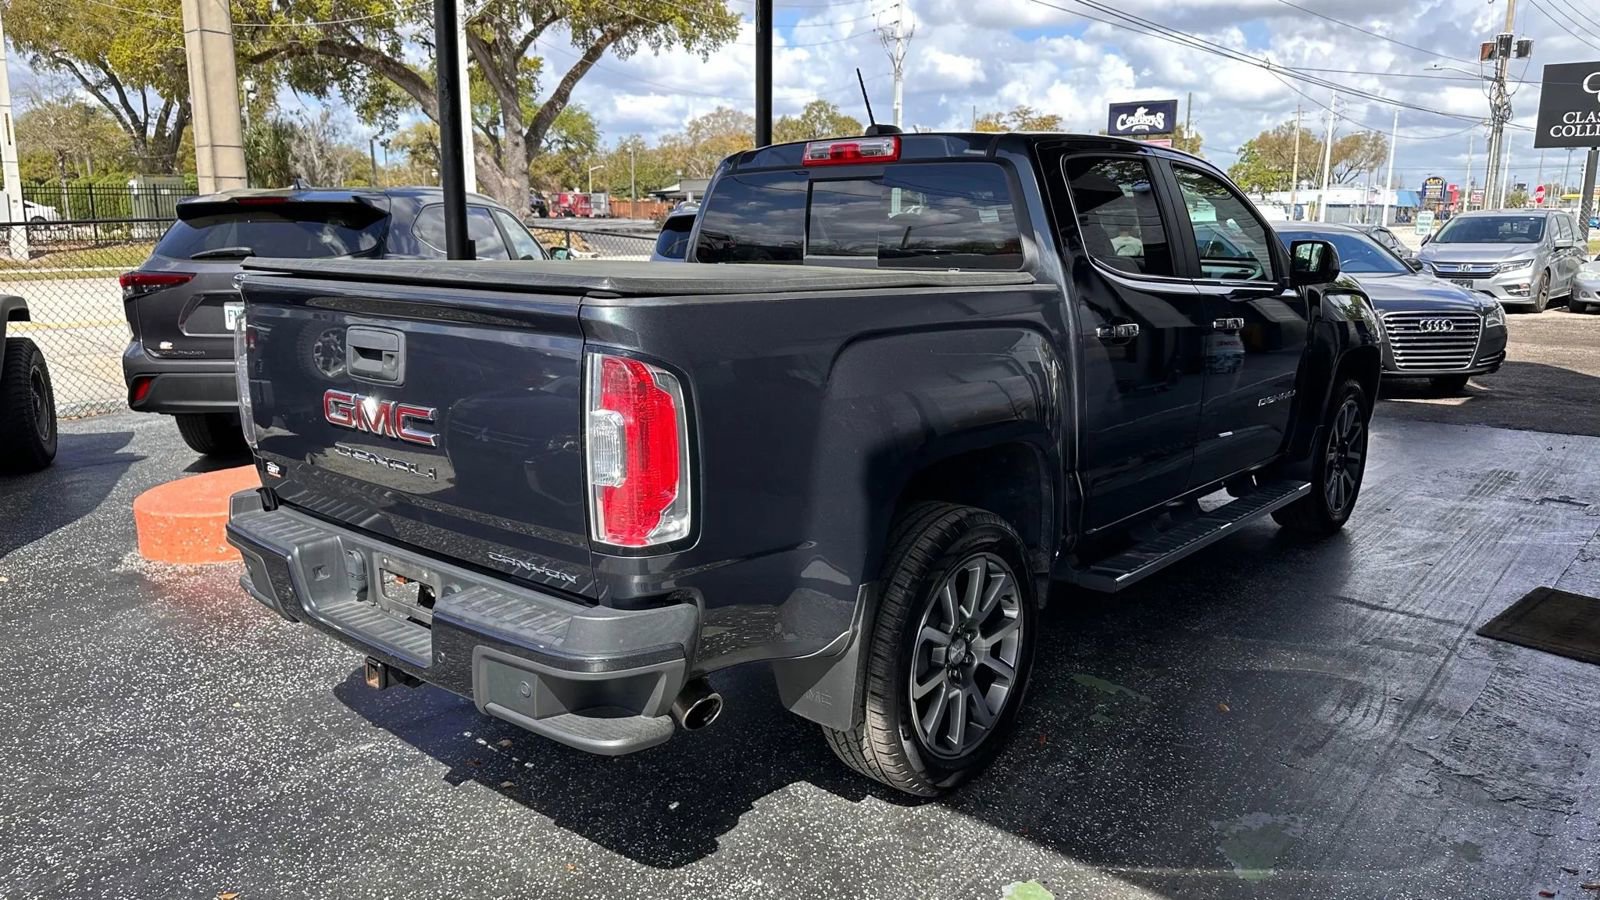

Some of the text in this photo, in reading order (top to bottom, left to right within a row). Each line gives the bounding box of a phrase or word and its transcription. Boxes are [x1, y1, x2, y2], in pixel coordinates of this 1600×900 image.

[1562, 111, 1600, 124] CLA
[323, 389, 440, 447] GMC
[334, 441, 438, 481] DENALI
[487, 551, 577, 584] CANYON
